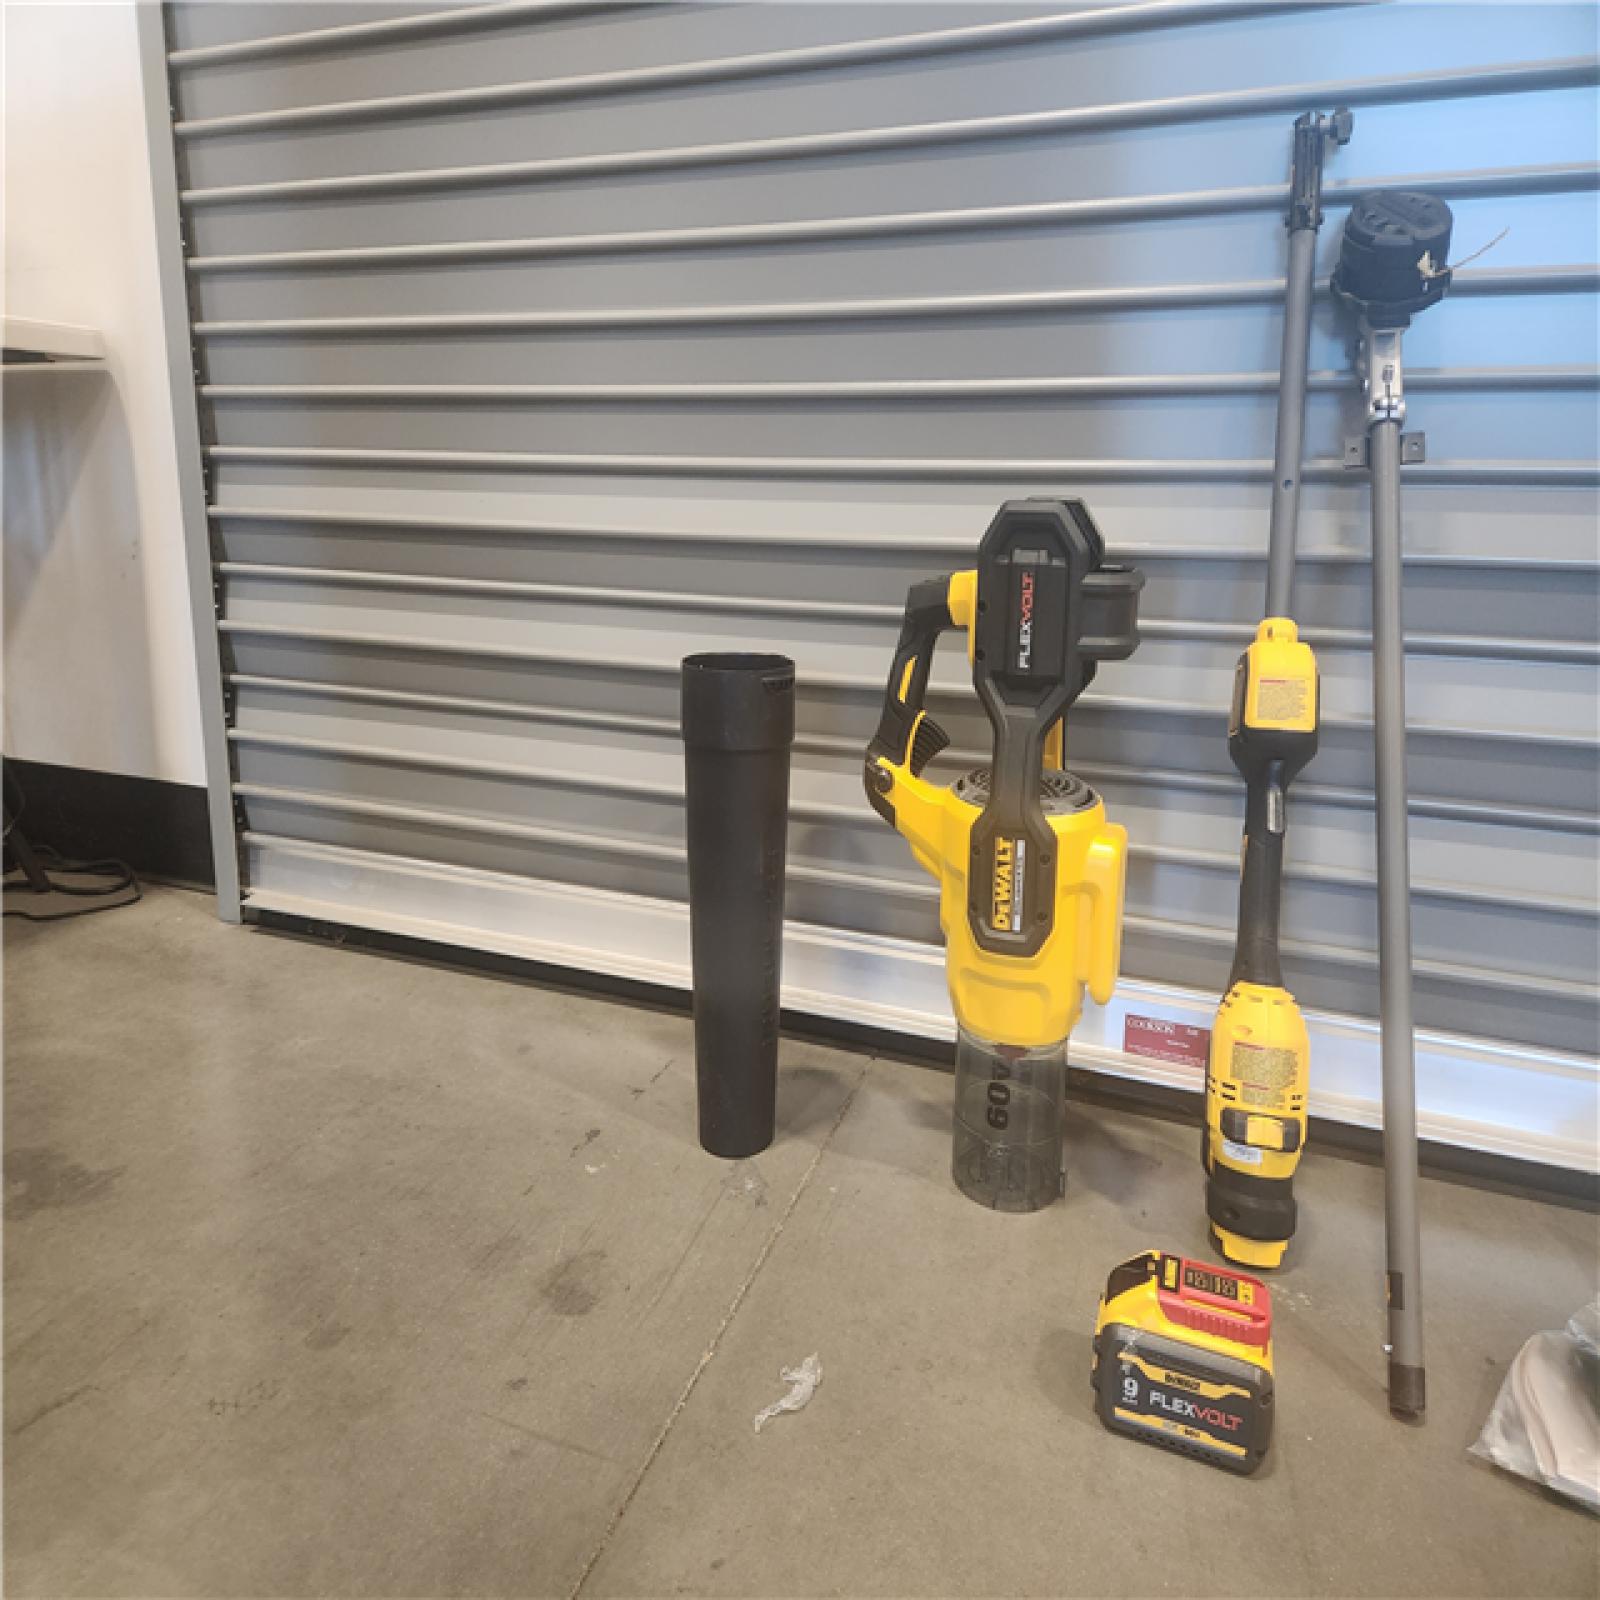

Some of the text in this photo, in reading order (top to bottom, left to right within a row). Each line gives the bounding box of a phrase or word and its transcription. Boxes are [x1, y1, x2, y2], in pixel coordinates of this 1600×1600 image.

[1019, 571, 1034, 669] FLEXVOLT
[1124, 1376, 1139, 1398] 9
[1149, 1390, 1244, 1431] FLEXVOLT
